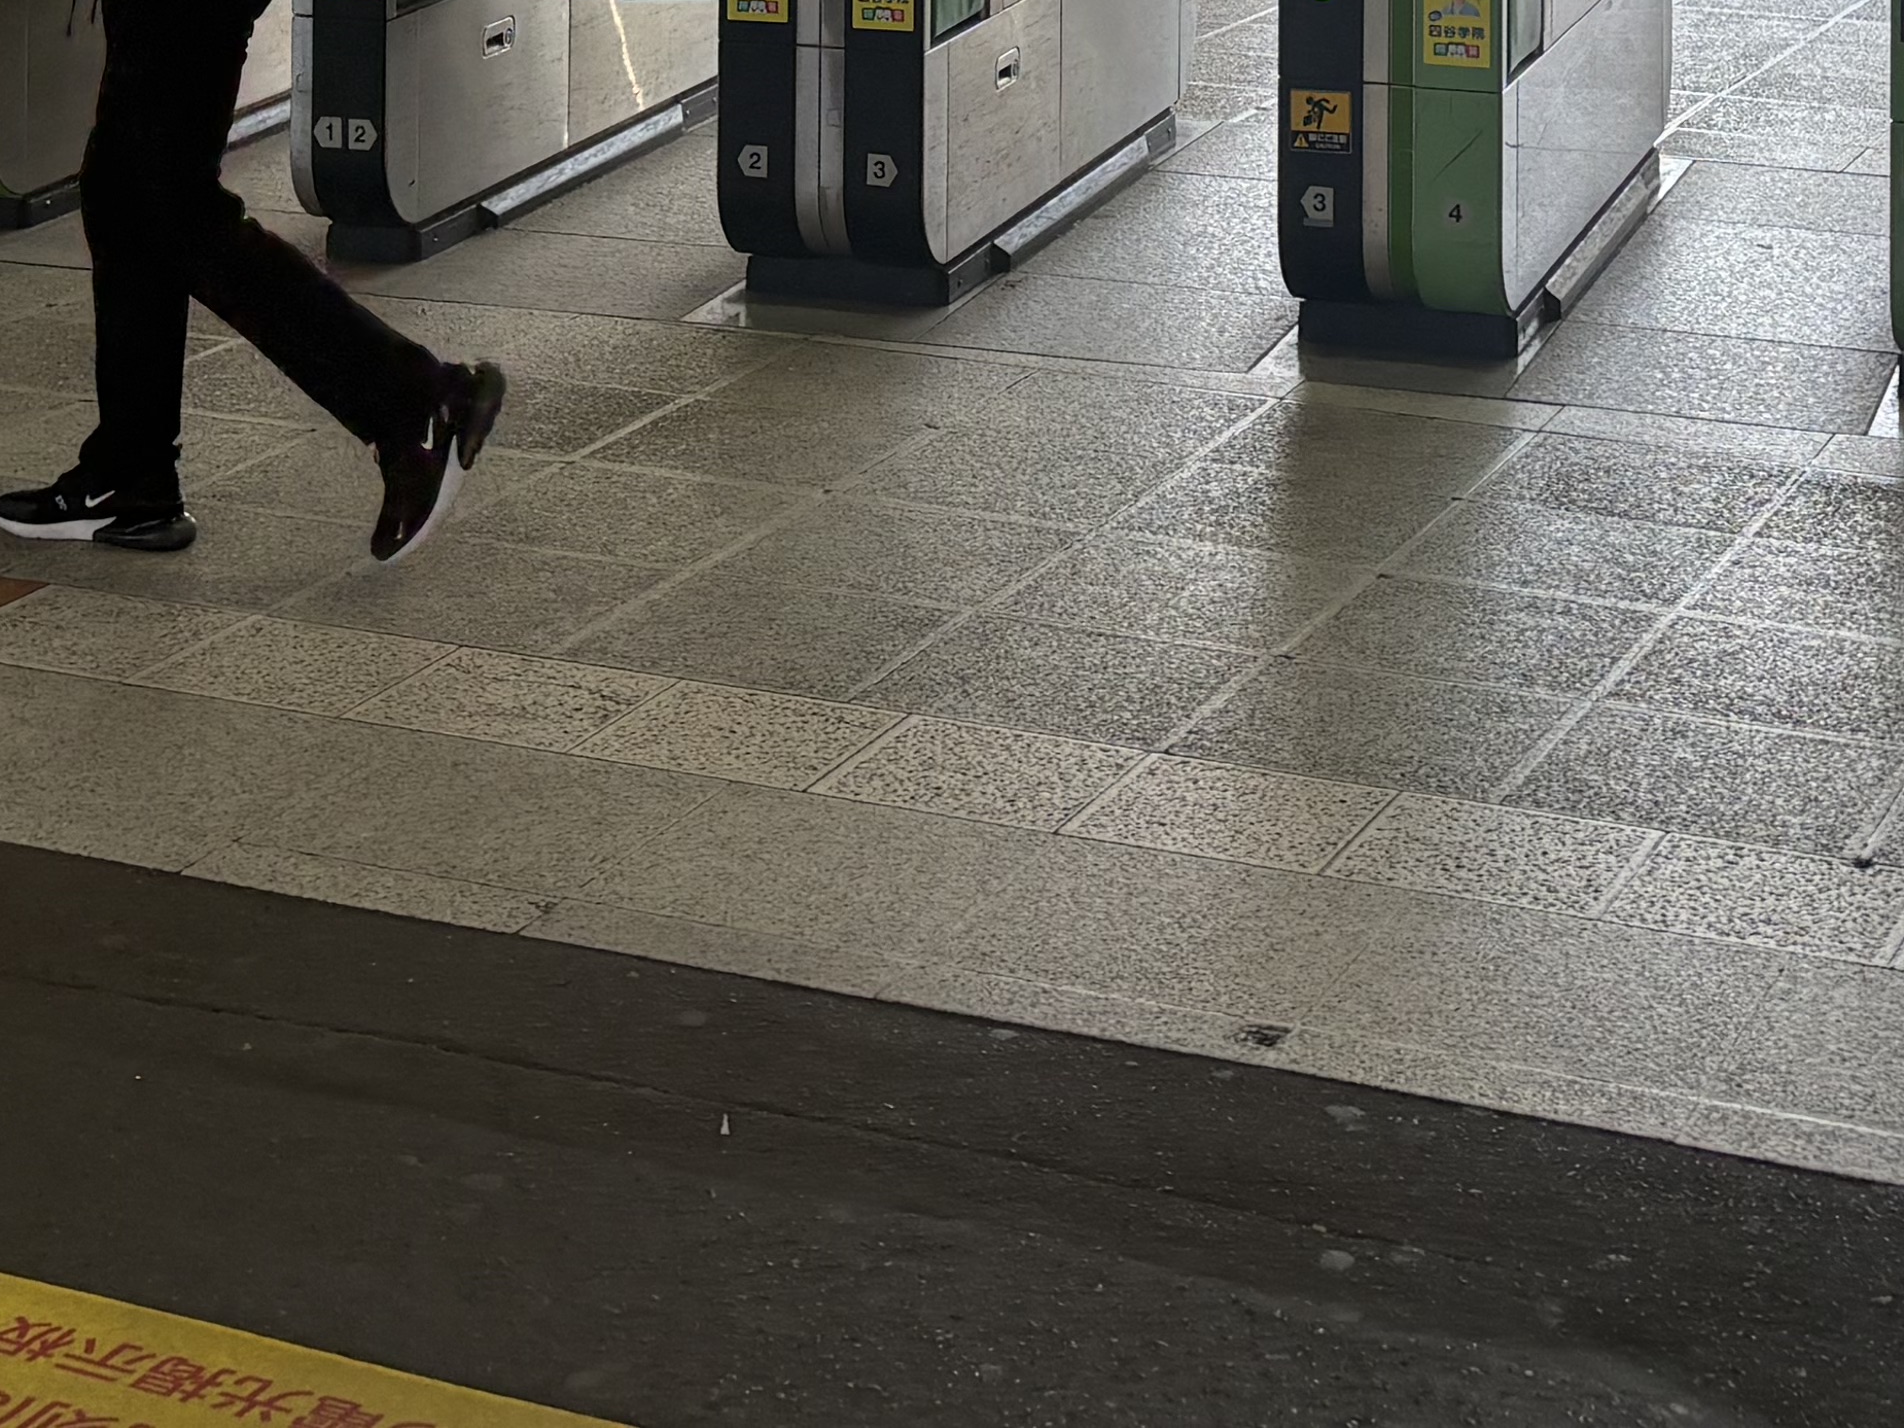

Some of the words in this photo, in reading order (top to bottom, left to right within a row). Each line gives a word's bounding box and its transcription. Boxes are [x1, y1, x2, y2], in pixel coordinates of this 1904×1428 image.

[324, 123, 335, 143] 1
[352, 124, 367, 145] 2
[747, 151, 763, 171] 2
[872, 160, 887, 180] 3
[1313, 192, 1327, 213] 3
[1448, 204, 1463, 223] 4
